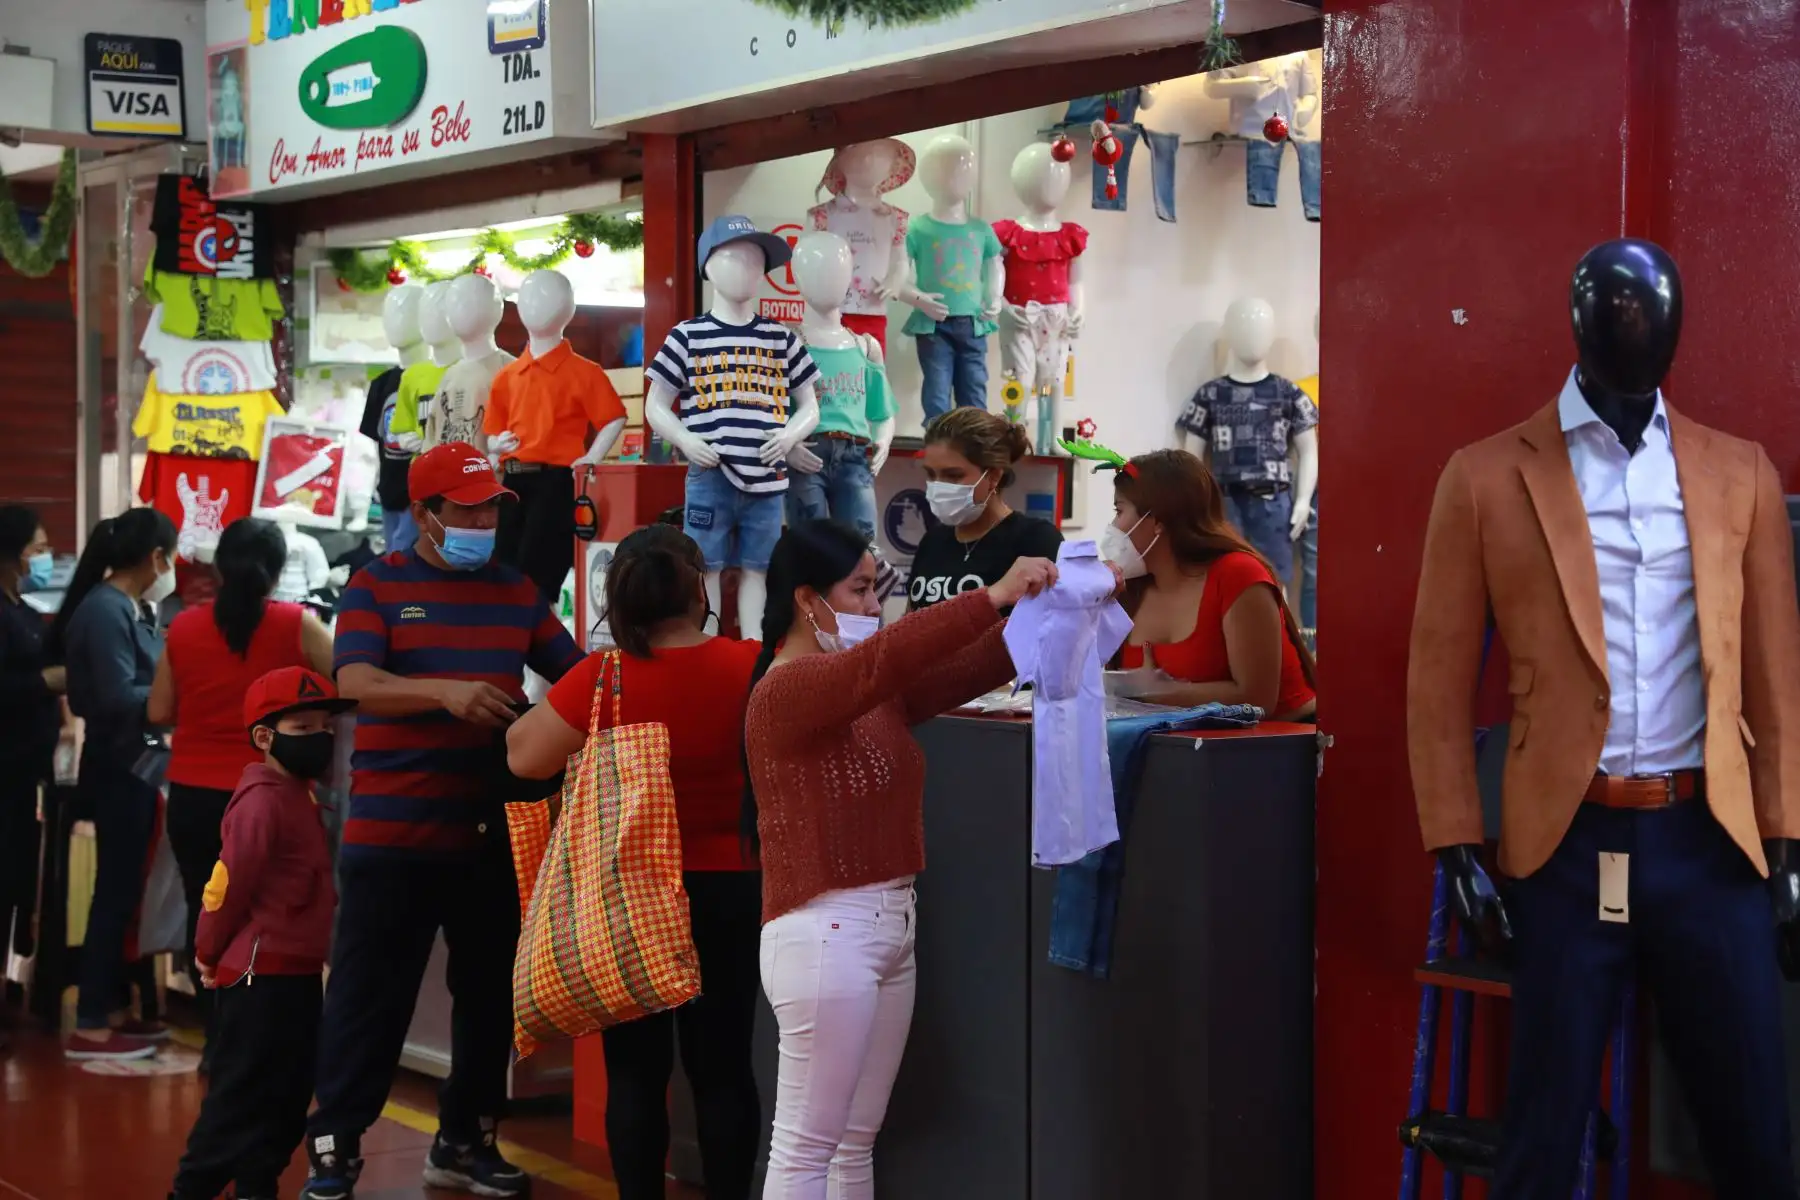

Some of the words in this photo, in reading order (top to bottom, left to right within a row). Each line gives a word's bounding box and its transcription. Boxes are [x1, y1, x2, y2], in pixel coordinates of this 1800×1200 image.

[102, 89, 169, 117] VISA
[269, 137, 298, 184] Con
[302, 135, 347, 176] Amor
[354, 131, 394, 173] para
[401, 129, 420, 155] su
[430, 100, 471, 148] Bebe
